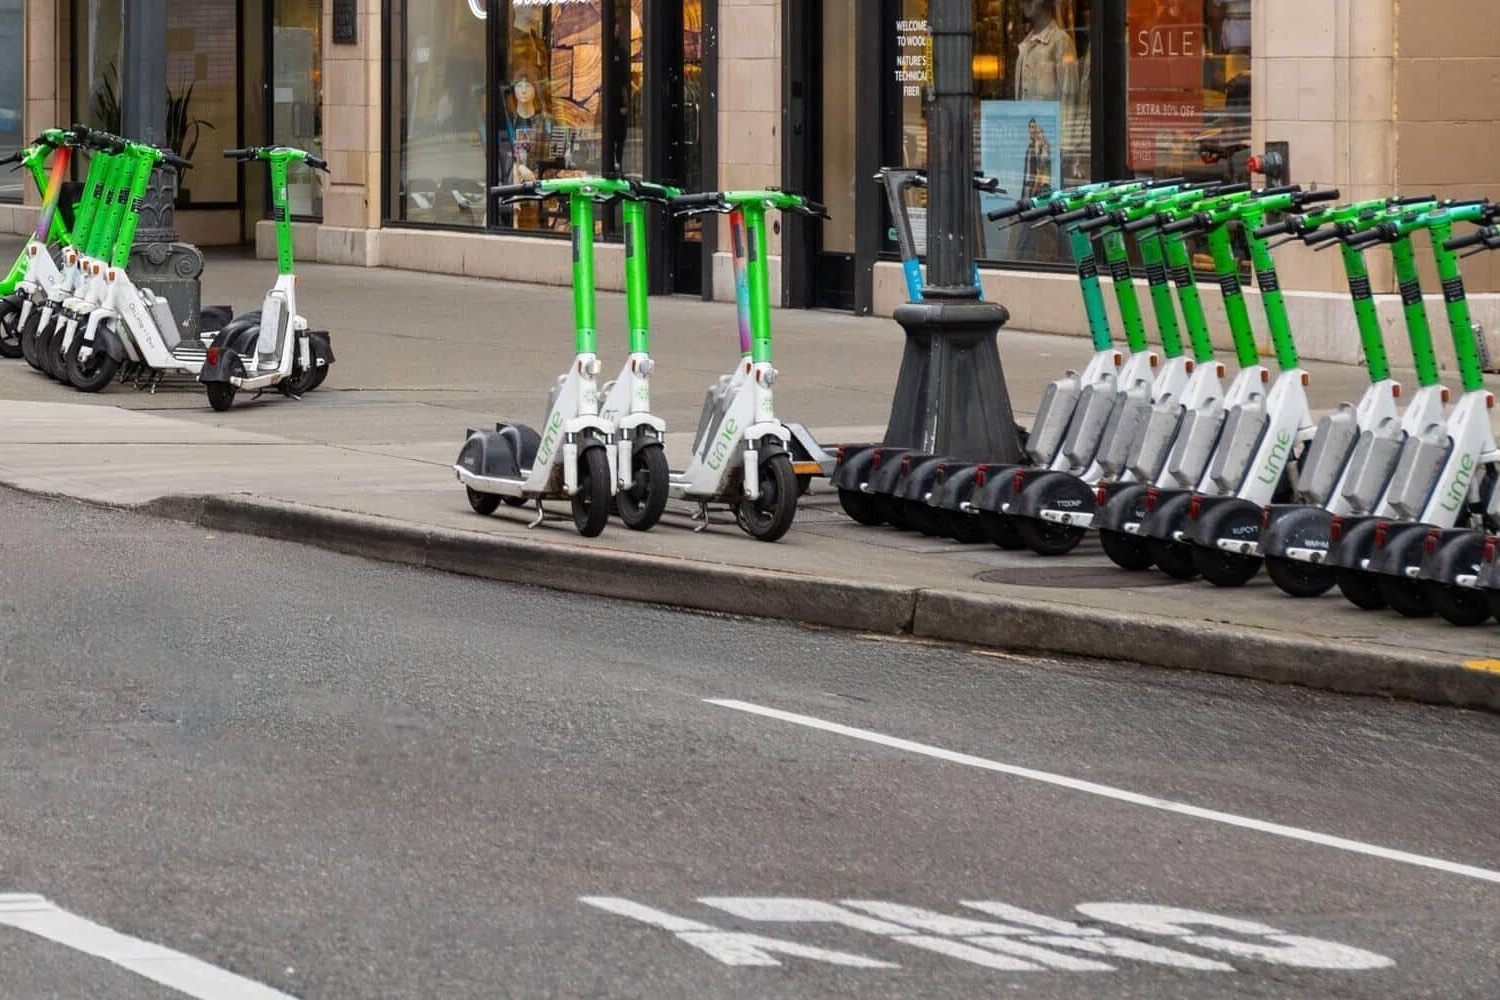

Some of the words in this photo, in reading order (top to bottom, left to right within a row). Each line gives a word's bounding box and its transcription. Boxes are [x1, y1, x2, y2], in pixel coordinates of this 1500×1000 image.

[896, 21, 928, 32] WELCOME
[897, 36, 906, 47] TO
[907, 36, 926, 47] WOOL
[1138, 30, 1194, 56] SALE
[897, 56, 927, 66] NATURE'S
[903, 86, 920, 97] FIBER
[1136, 104, 1161, 116] EXTRA
[1180, 105, 1196, 118] OFF
[536, 410, 564, 467] Lime
[1257, 429, 1291, 485] Lime
[1440, 452, 1477, 513] Lime
[576, 896, 1397, 972] ONLY
